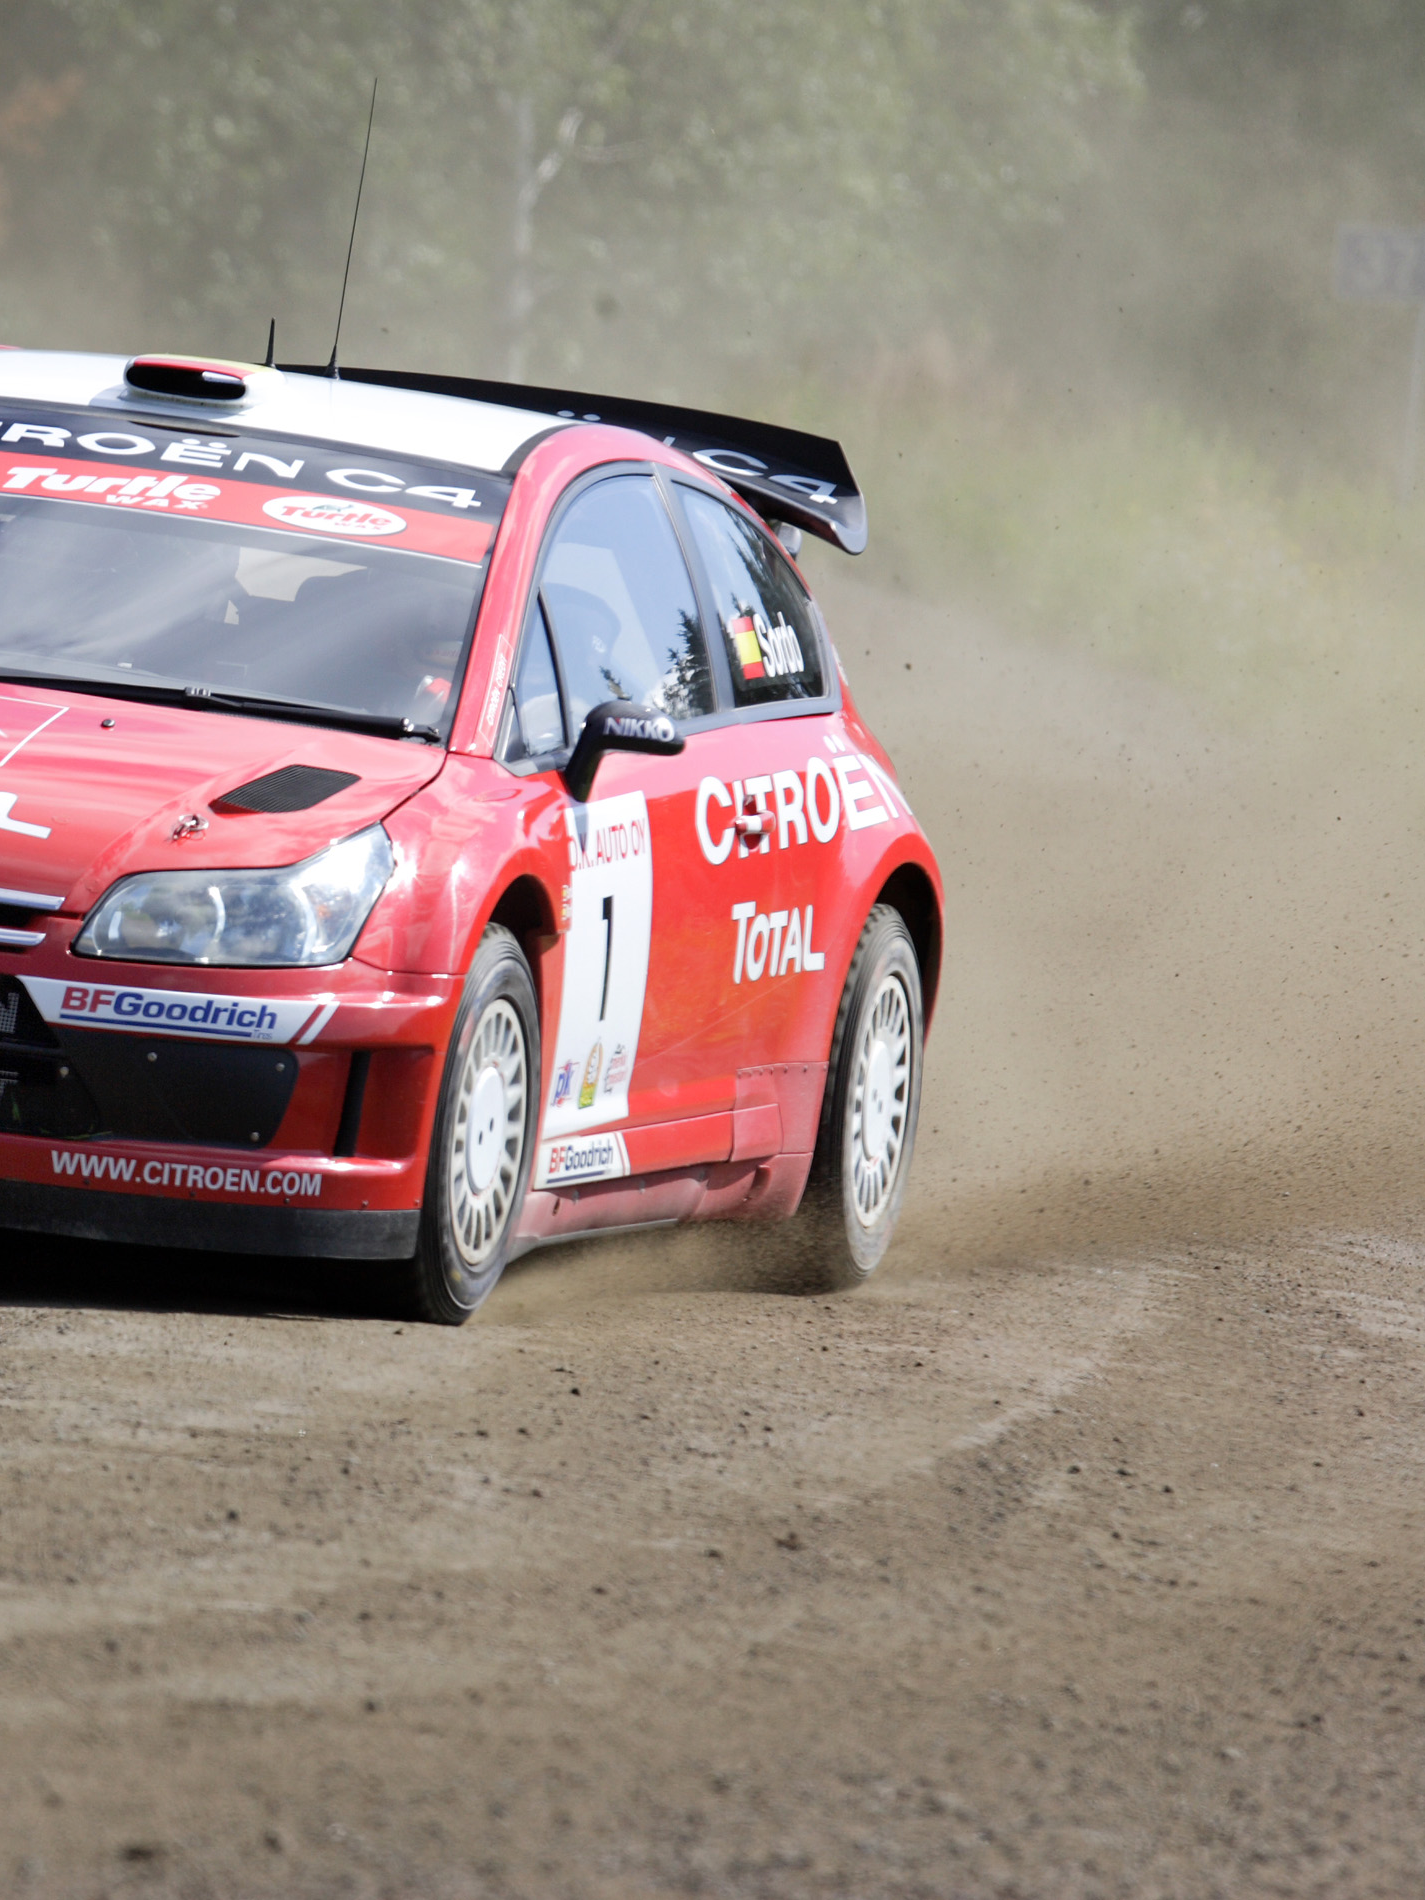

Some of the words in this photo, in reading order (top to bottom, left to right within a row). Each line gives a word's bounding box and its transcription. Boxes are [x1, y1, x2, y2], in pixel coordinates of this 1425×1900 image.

[2, 467, 221, 501] Turtle
[325, 468, 481, 509] C4
[692, 448, 838, 505] C4
[105, 494, 203, 510] WAX
[281, 505, 392, 526] Turtle
[753, 611, 805, 678] Sordo
[603, 716, 674, 743] NIKKO
[695, 734, 914, 866] CITROËN
[596, 823, 628, 866] AUTO
[631, 817, 646, 856] OY
[599, 894, 615, 1022] 1
[731, 901, 825, 984] TOTAL
[60, 986, 278, 1030] BFGoodrich
[51, 1150, 323, 1197] WWW.CITROEN.COM
[548, 1138, 614, 1174] BFGoodrich
